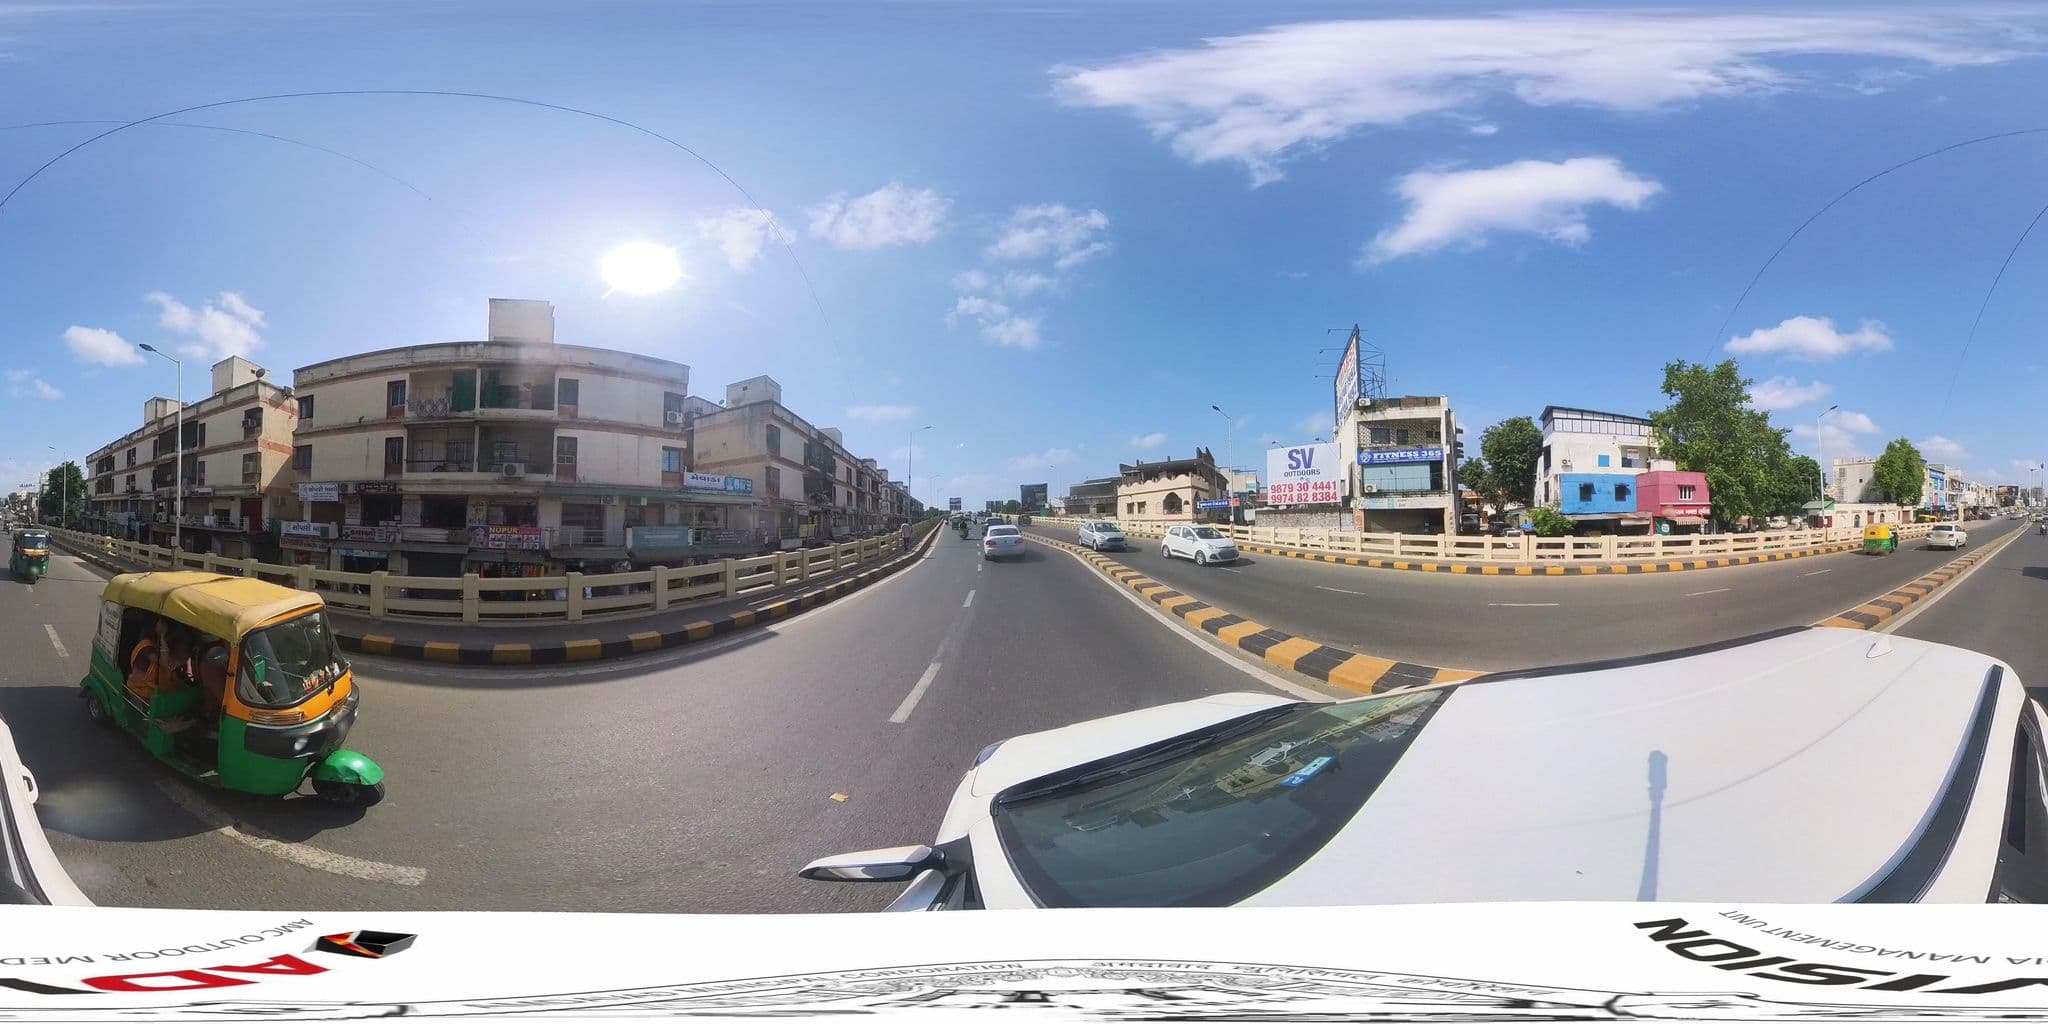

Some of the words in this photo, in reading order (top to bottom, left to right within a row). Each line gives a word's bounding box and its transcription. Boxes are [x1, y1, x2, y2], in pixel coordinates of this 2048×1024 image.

[1288, 448, 1315, 470] SV
[1373, 451, 1419, 459] FITNESS
[1284, 469, 1321, 477] OUTDOORS
[1271, 483, 1294, 494] 9879
[1296, 482, 1309, 492] 30
[1312, 481, 1337, 491] 4441
[1271, 493, 1294, 504] 9974
[1297, 493, 1309, 502] 82
[1312, 491, 1338, 502] 8384
[489, 526, 518, 534] NUPUR
